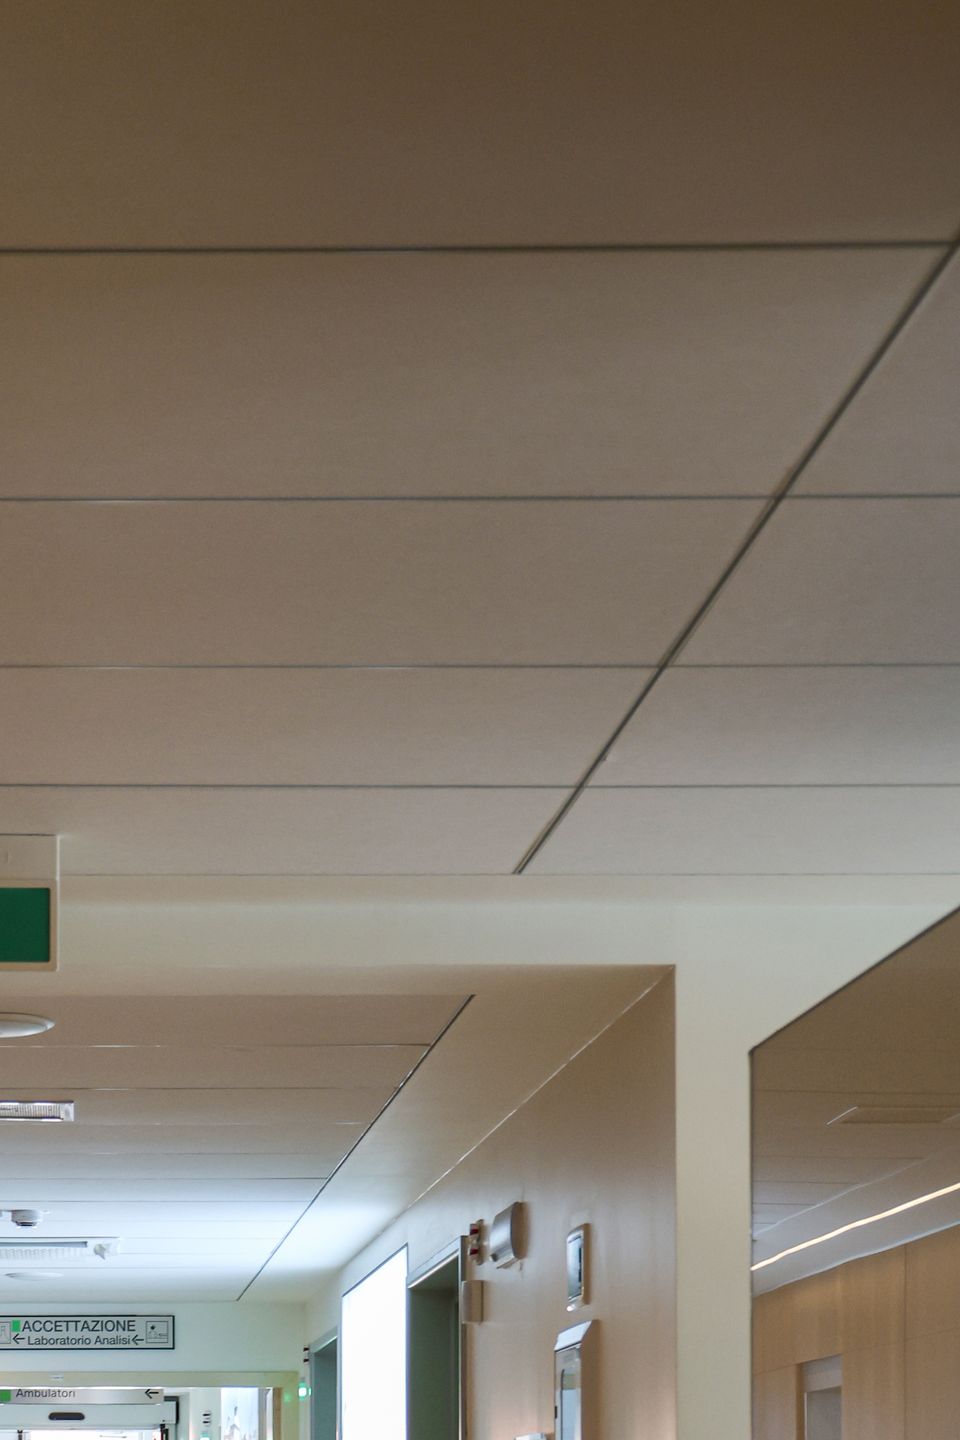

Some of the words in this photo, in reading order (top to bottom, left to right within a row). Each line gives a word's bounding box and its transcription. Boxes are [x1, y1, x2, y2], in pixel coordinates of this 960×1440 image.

[21, 1319, 136, 1332] ACCETTAZIONE
[27, 1335, 92, 1346] Laboratorio
[94, 1335, 131, 1345] Analisi
[15, 1388, 76, 1398] Ambulatori
